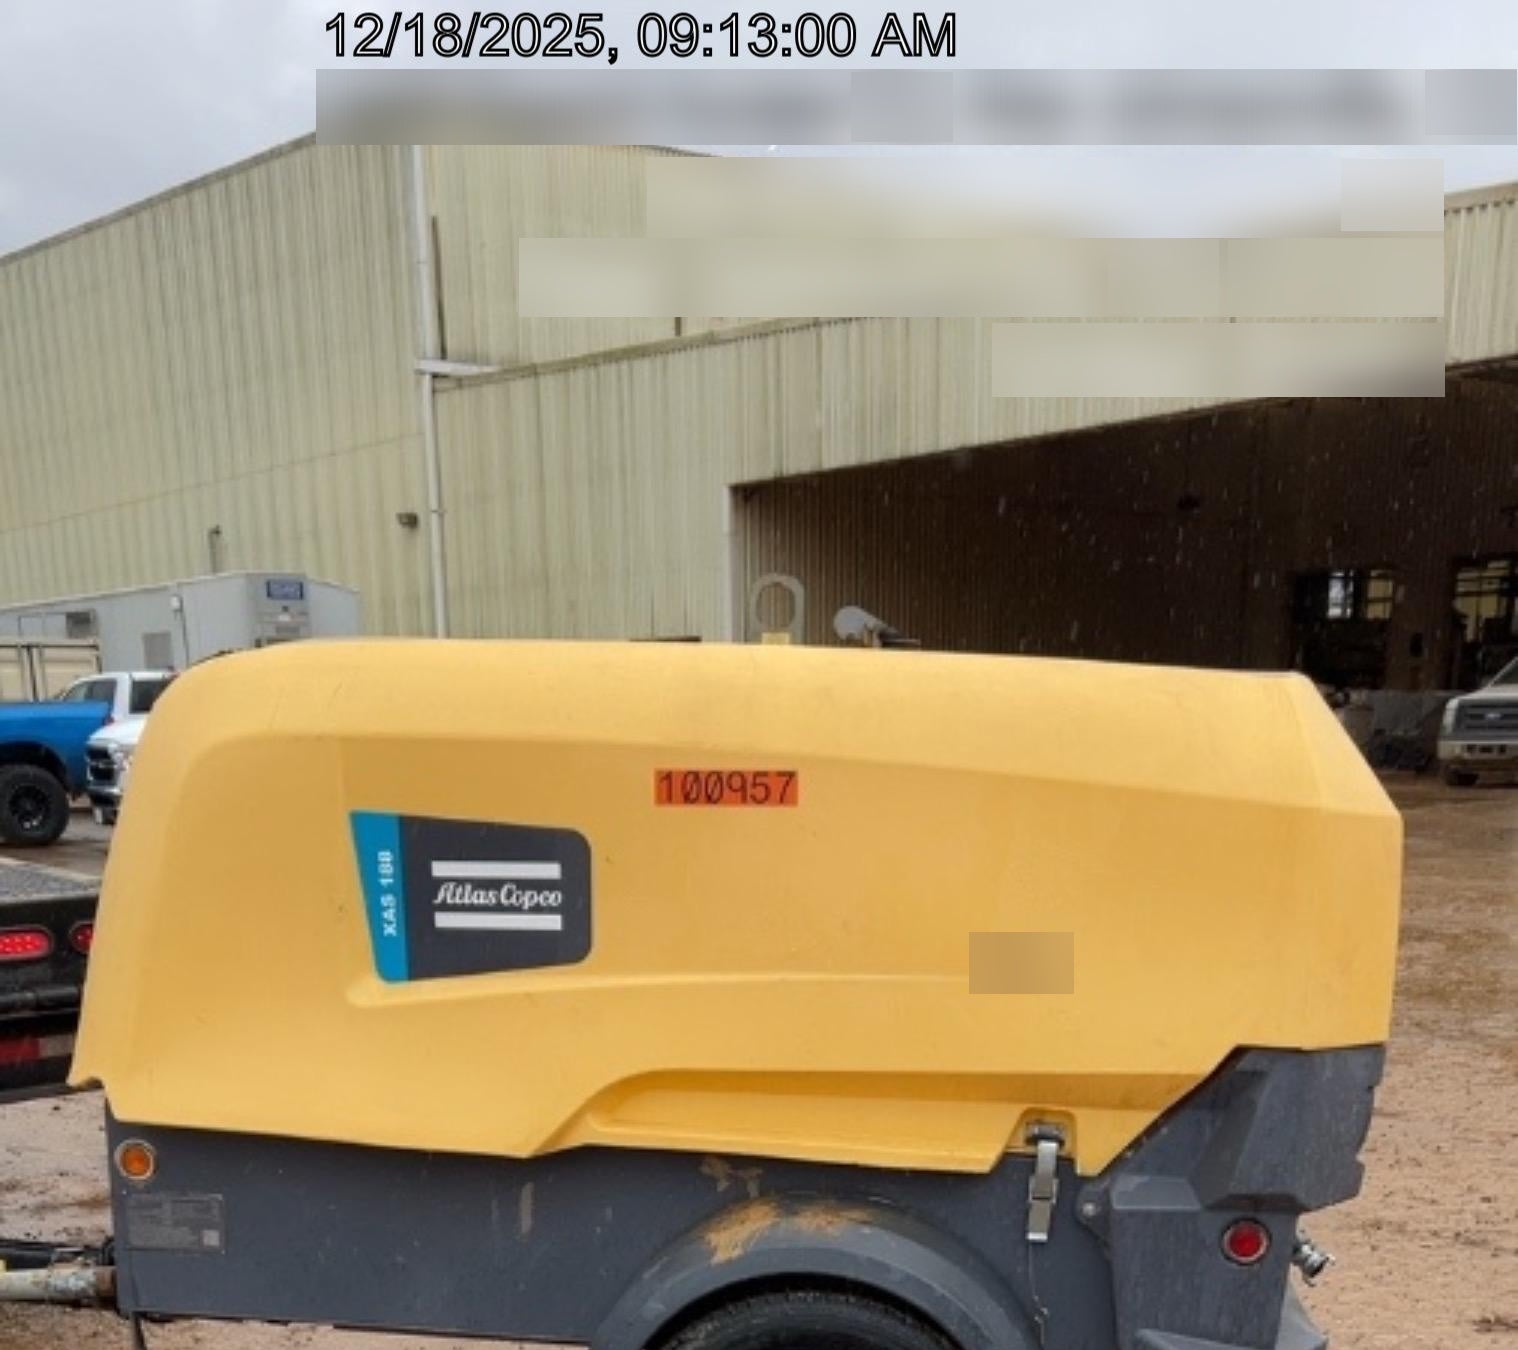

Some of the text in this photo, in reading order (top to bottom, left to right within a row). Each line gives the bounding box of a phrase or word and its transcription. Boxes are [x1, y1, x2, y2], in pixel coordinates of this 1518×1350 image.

[658, 770, 796, 804] 100957
[432, 881, 563, 910] Atlas Copco
[380, 894, 397, 937] XAS
